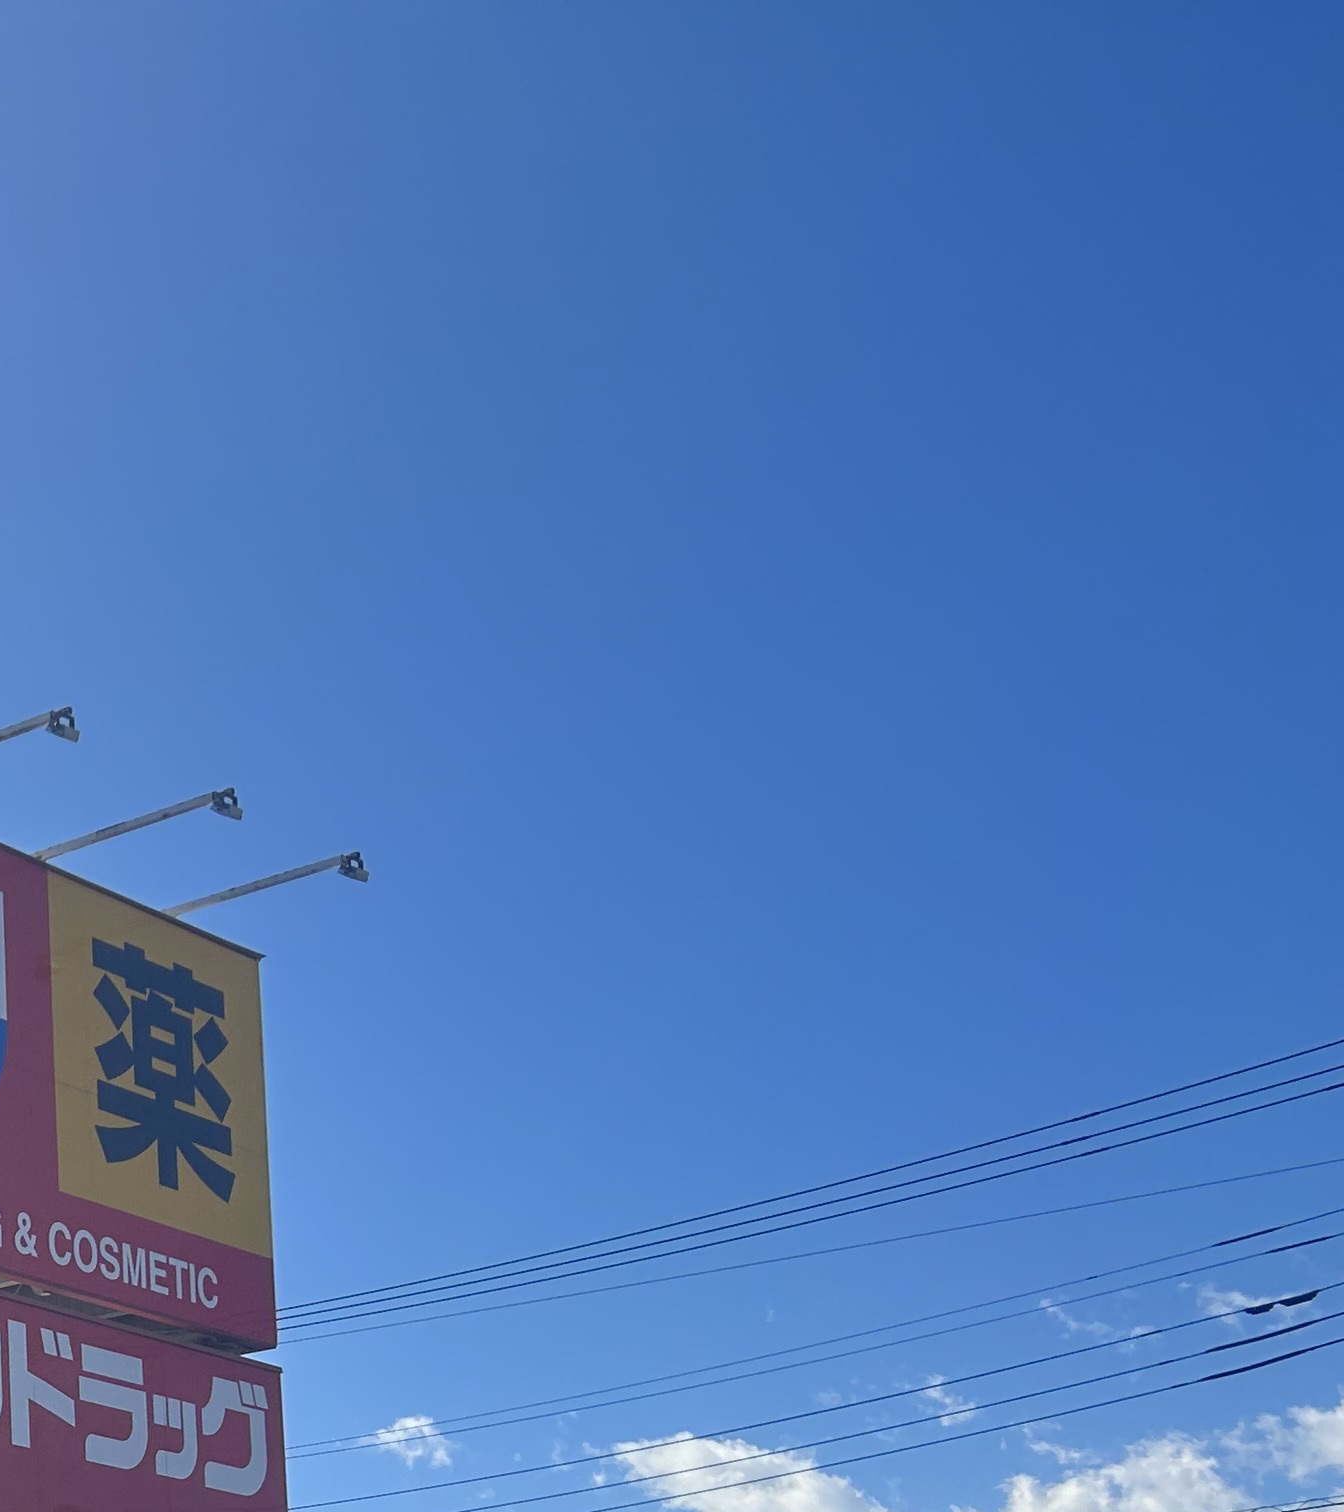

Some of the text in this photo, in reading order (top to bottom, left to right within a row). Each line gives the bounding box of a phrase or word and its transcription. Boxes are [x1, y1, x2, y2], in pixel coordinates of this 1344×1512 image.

[91, 936, 235, 1204] 薬
[14, 1212, 38, 1259] &
[49, 1222, 218, 1309] COSMETIC
